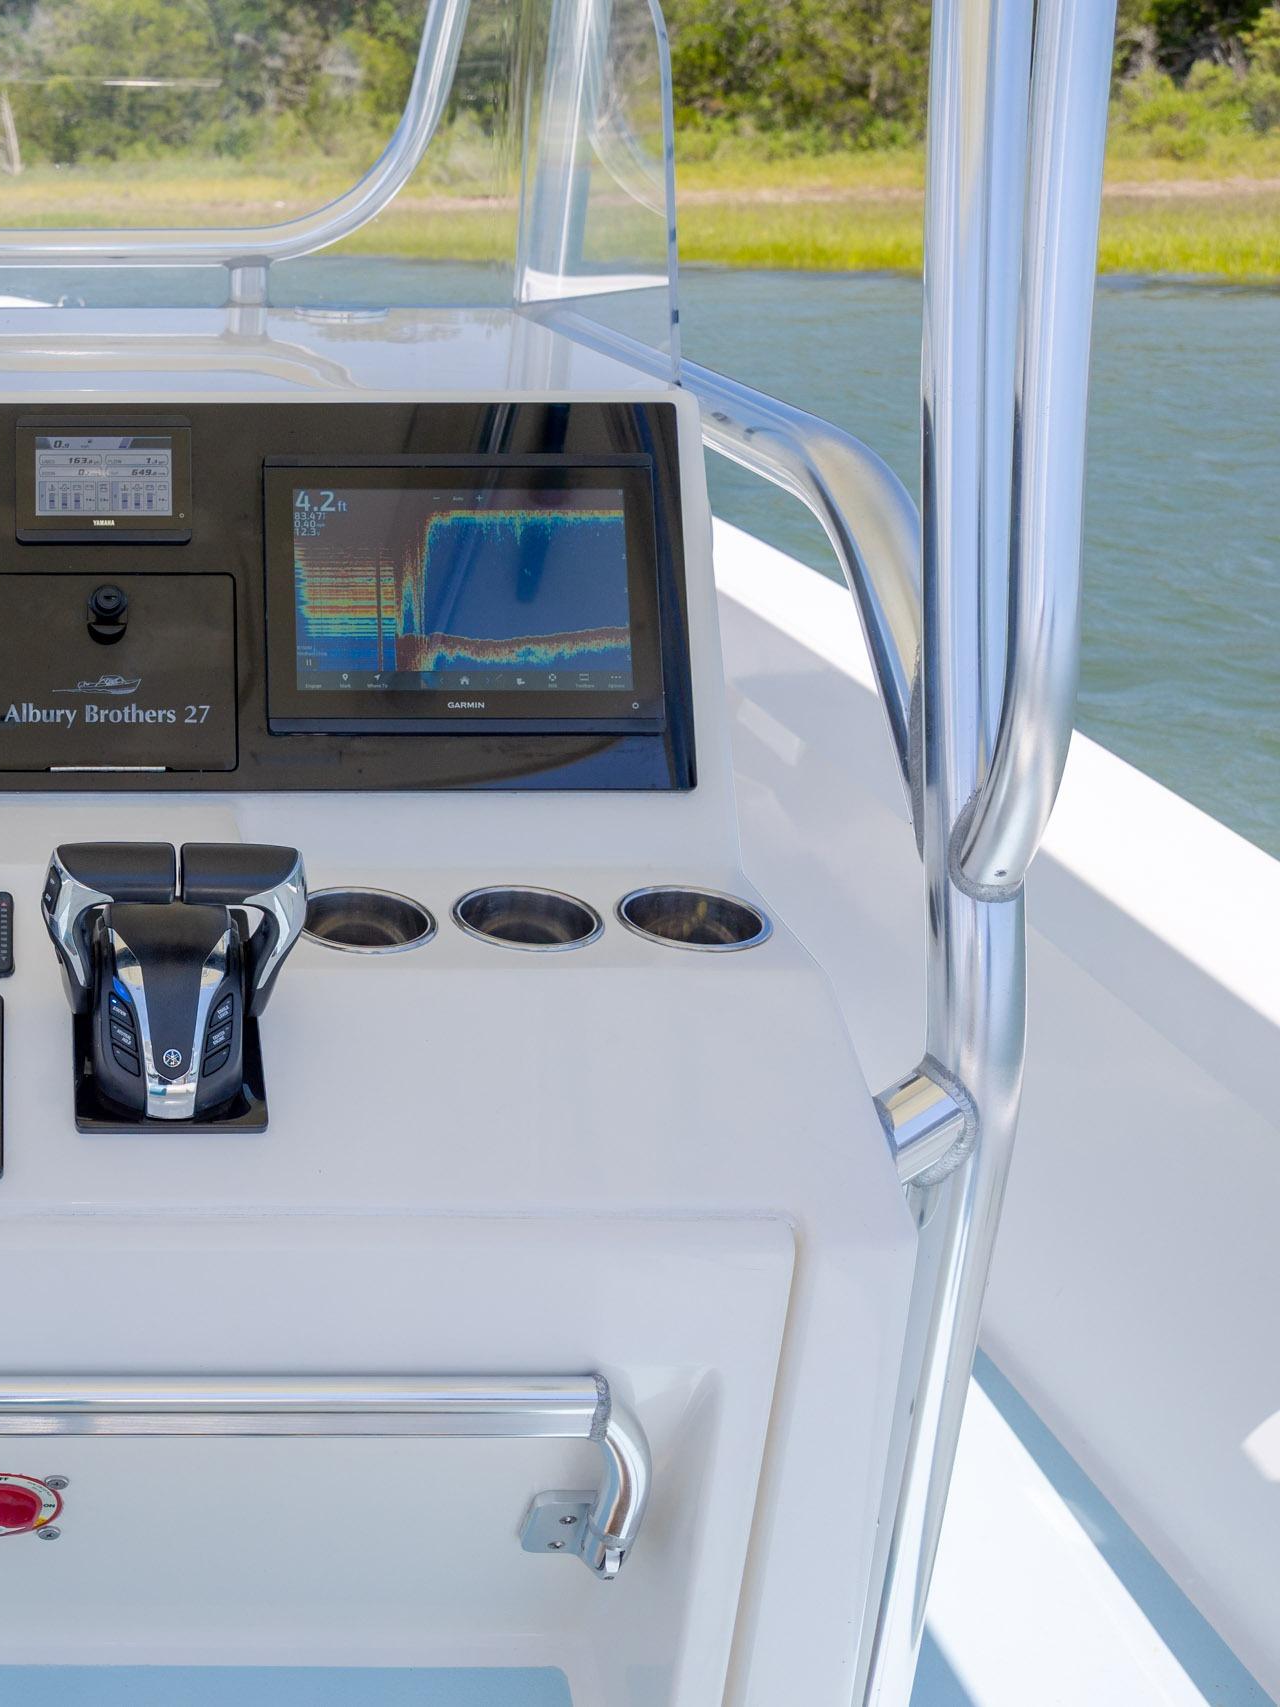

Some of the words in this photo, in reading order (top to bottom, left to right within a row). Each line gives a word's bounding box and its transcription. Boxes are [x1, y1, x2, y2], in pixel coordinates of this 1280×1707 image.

[295, 491, 336, 511] 4.2
[338, 501, 348, 512] ft
[4, 703, 77, 728] Albury
[85, 703, 177, 723] Brothers
[184, 705, 211, 724] 27
